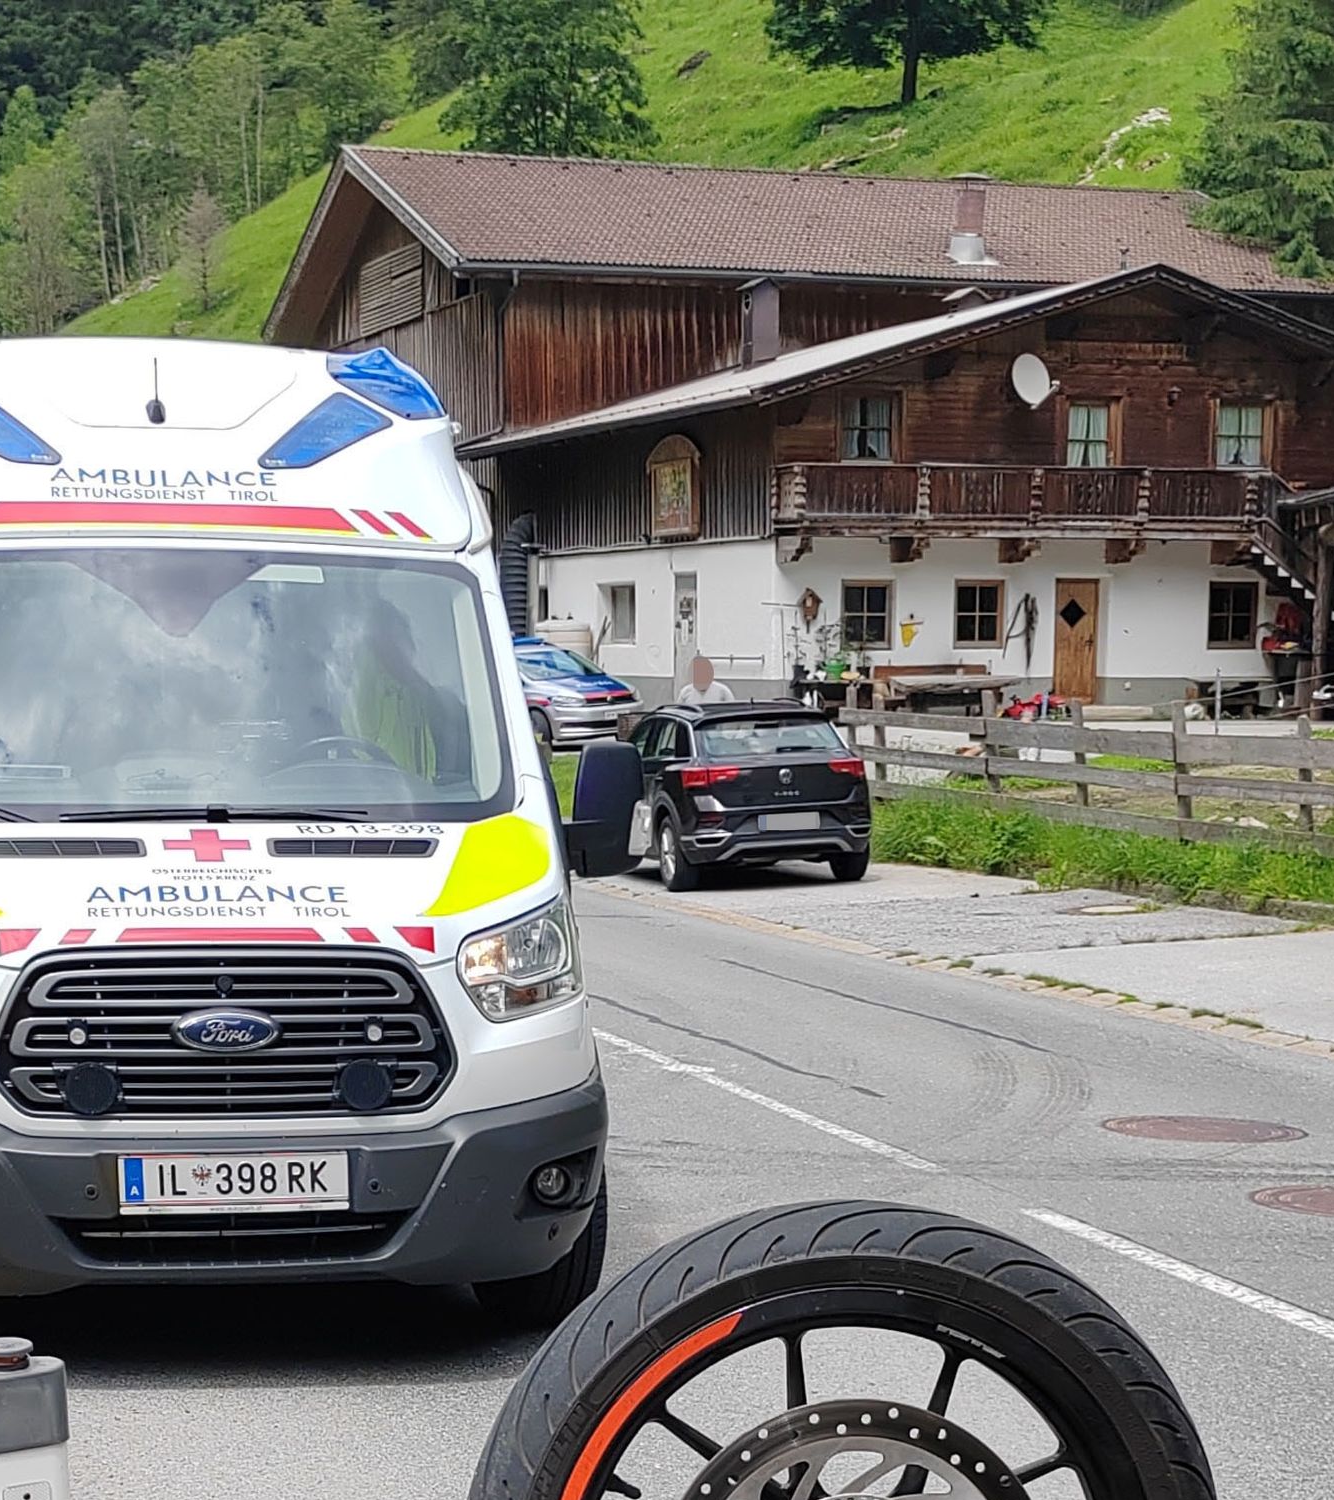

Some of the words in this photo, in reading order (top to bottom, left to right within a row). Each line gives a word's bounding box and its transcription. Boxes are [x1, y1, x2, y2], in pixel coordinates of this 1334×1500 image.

[50, 468, 278, 488] AMBULANCE
[50, 486, 207, 501] RETTUNGSDIENST
[228, 490, 279, 502] TIROL
[296, 824, 337, 835] RD
[347, 824, 445, 836] 13-398
[87, 885, 349, 903] AMBULANCE
[86, 906, 267, 918] RETTUNGSDIENST
[292, 906, 352, 918] TIROL
[200, 1019, 255, 1043] Ford
[129, 1185, 140, 1197] A
[158, 1164, 188, 1197] IL
[215, 1162, 278, 1195] 398
[286, 1160, 329, 1193] RK
